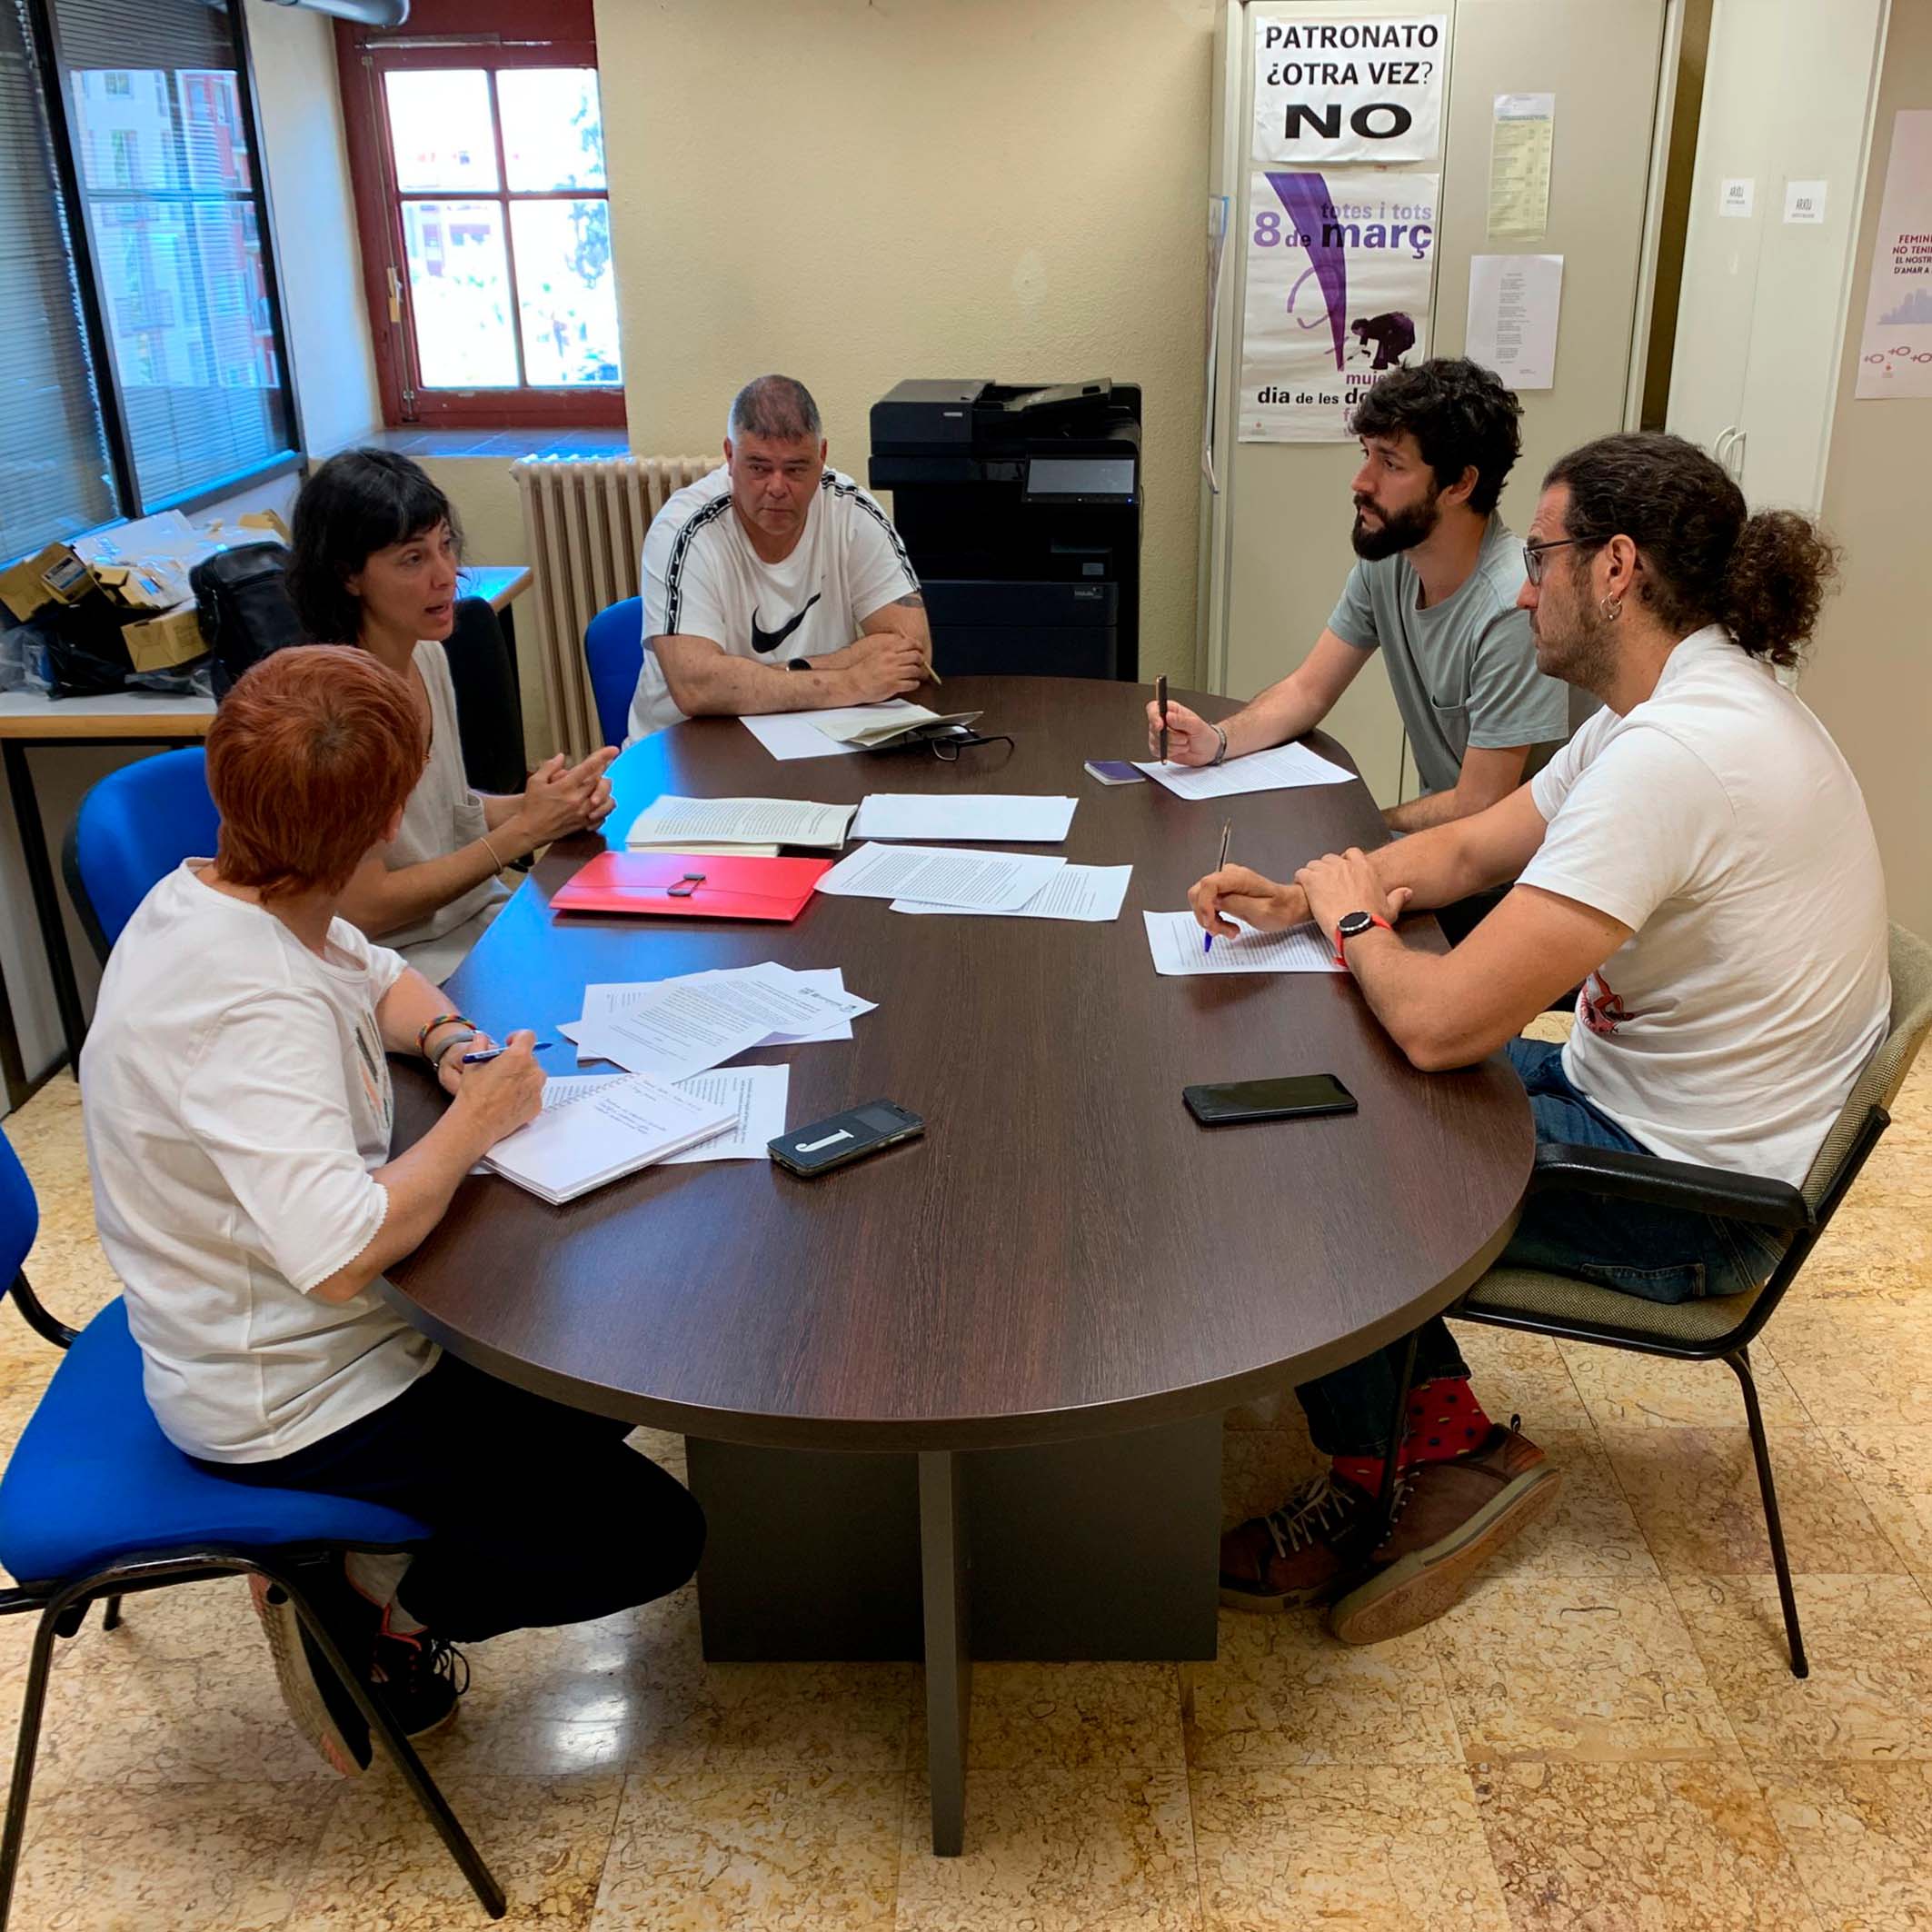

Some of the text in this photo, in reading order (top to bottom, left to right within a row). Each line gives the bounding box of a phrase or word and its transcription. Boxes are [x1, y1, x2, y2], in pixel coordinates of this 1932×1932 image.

[1266, 25, 1438, 48] PATRONATO
[1267, 61, 1433, 85] ¿OTRA VEZ?
[1285, 103, 1412, 139] NO
[1320, 202, 1432, 220] totes i tots
[1253, 211, 1432, 259] 8 de març
[1892, 245, 1907, 254] NO
[1258, 386, 1290, 403] dia
[1296, 393, 1313, 404] de
[1319, 393, 1339, 404] les
[795, 1129, 854, 1152] J
